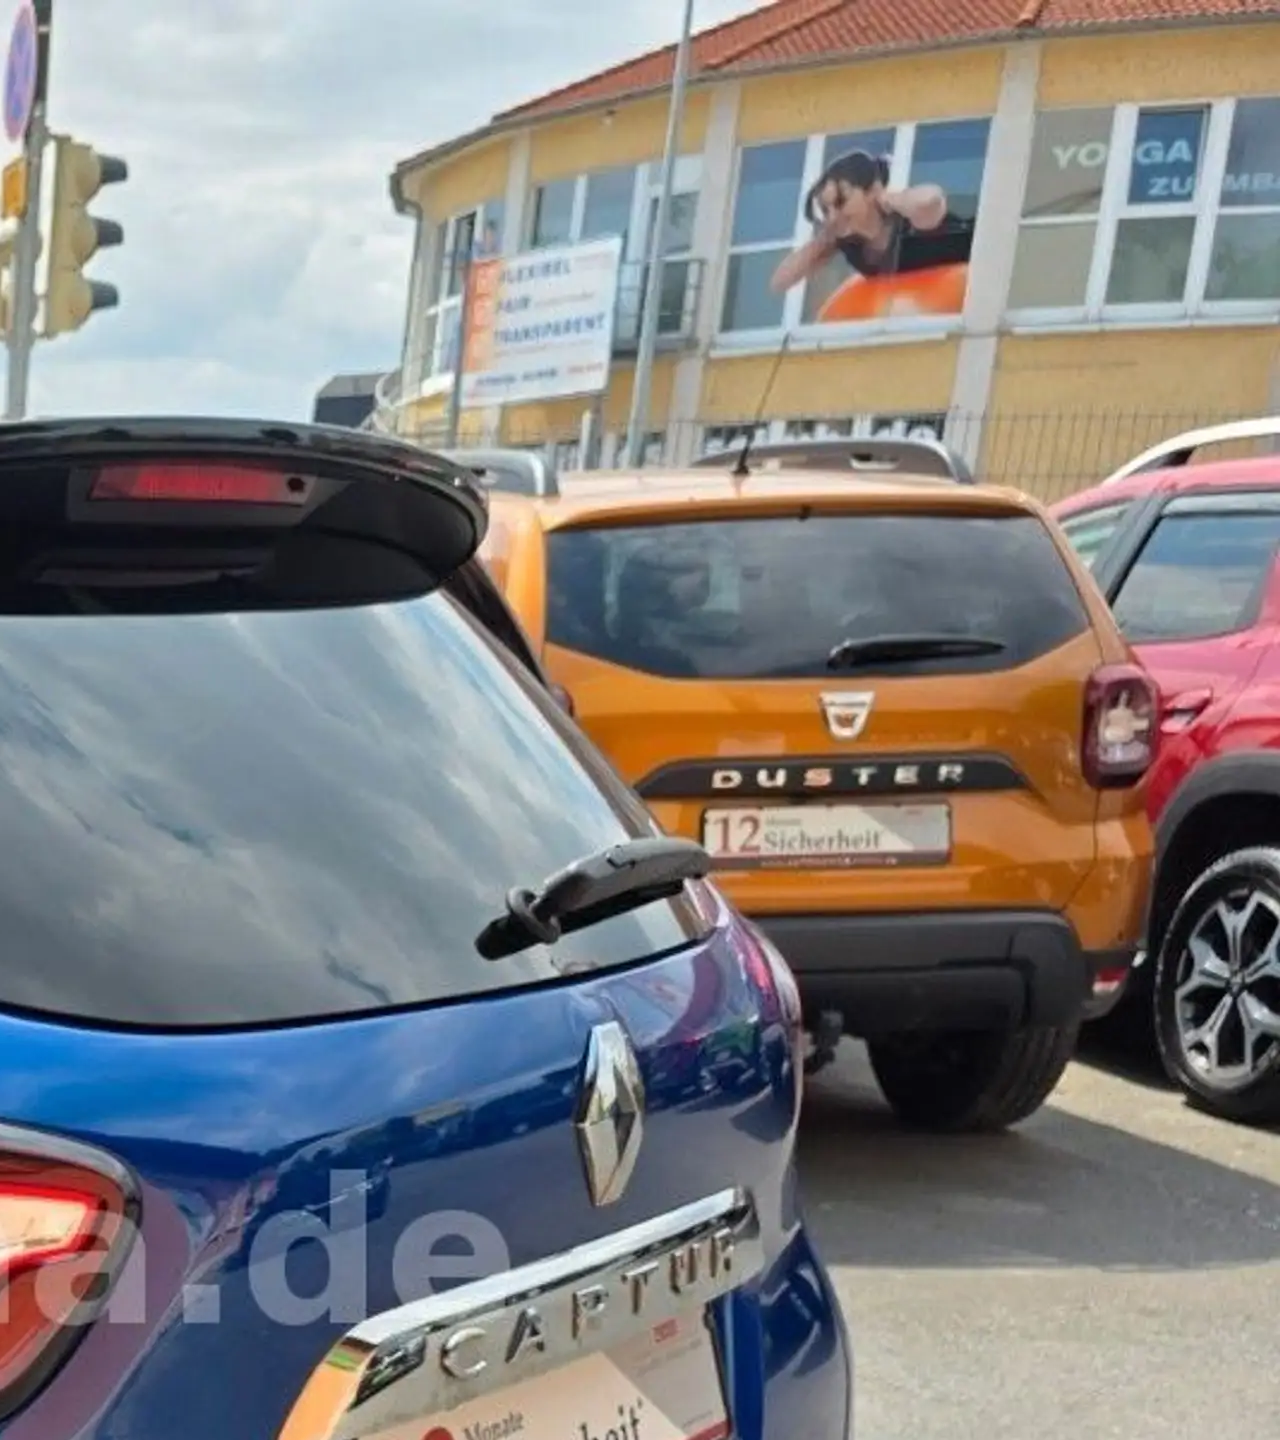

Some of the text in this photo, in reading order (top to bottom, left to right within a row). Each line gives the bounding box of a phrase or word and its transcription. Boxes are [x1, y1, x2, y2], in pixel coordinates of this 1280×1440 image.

[1052, 138, 1194, 170] YOGA
[1148, 173, 1280, 197] ZUMB
[711, 763, 964, 789] DUSTER
[714, 815, 761, 854] 12
[764, 829, 882, 851] Sicherheit
[440, 1227, 737, 1379] CAPTUR
